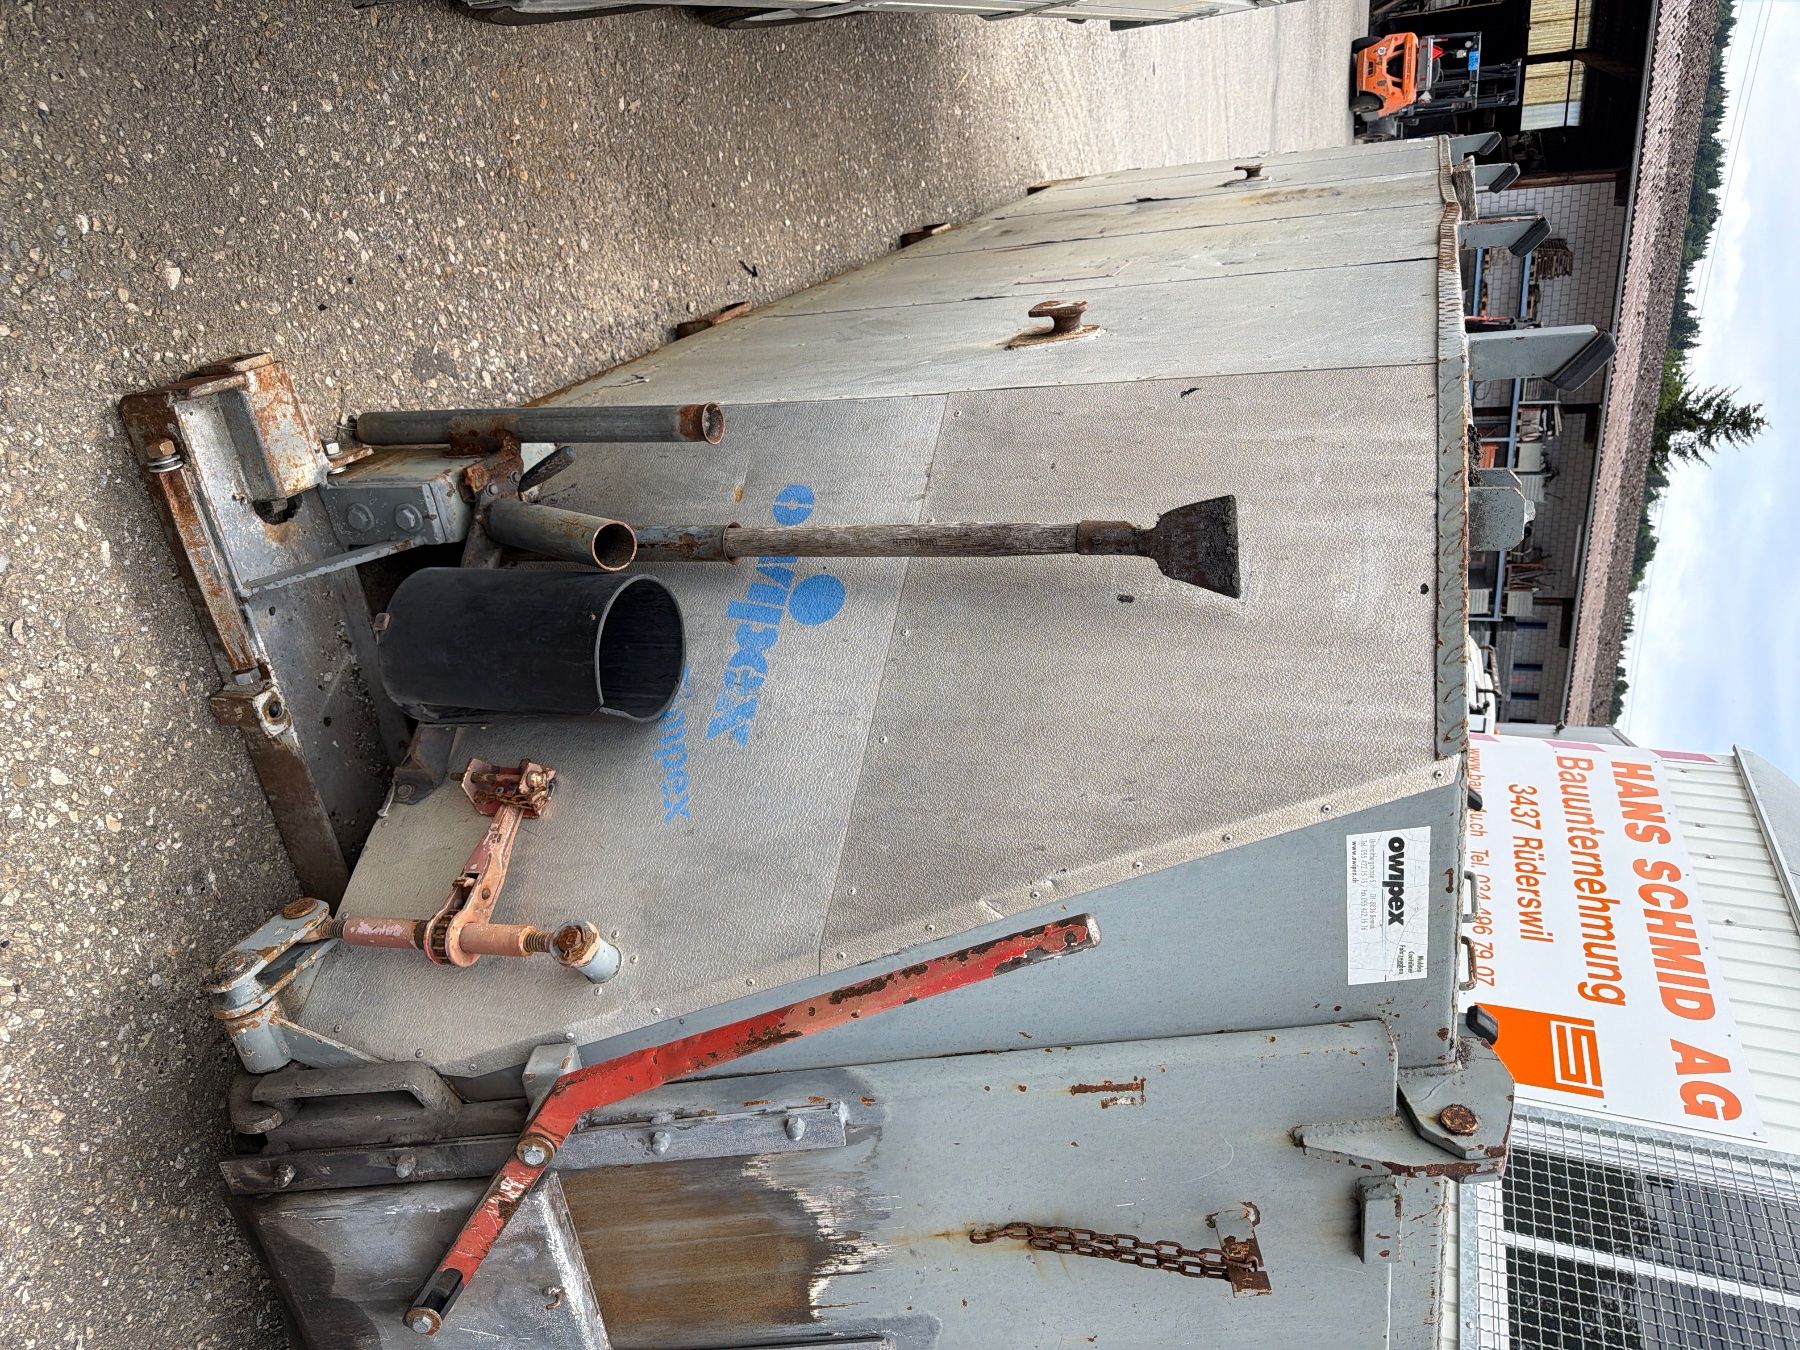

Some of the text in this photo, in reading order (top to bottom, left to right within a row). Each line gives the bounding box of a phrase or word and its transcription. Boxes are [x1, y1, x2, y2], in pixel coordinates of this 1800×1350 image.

[1382, 836, 1405, 926] owipex
[1471, 850, 1489, 868] Tel.
[1508, 784, 1554, 942] 3437 Rüderswil
[1556, 756, 1626, 1006] Bauunternehmung
[1474, 942, 1494, 959] 79
[1476, 966, 1494, 986] 07
[1611, 762, 1742, 1122] HANS SCHMID AG
